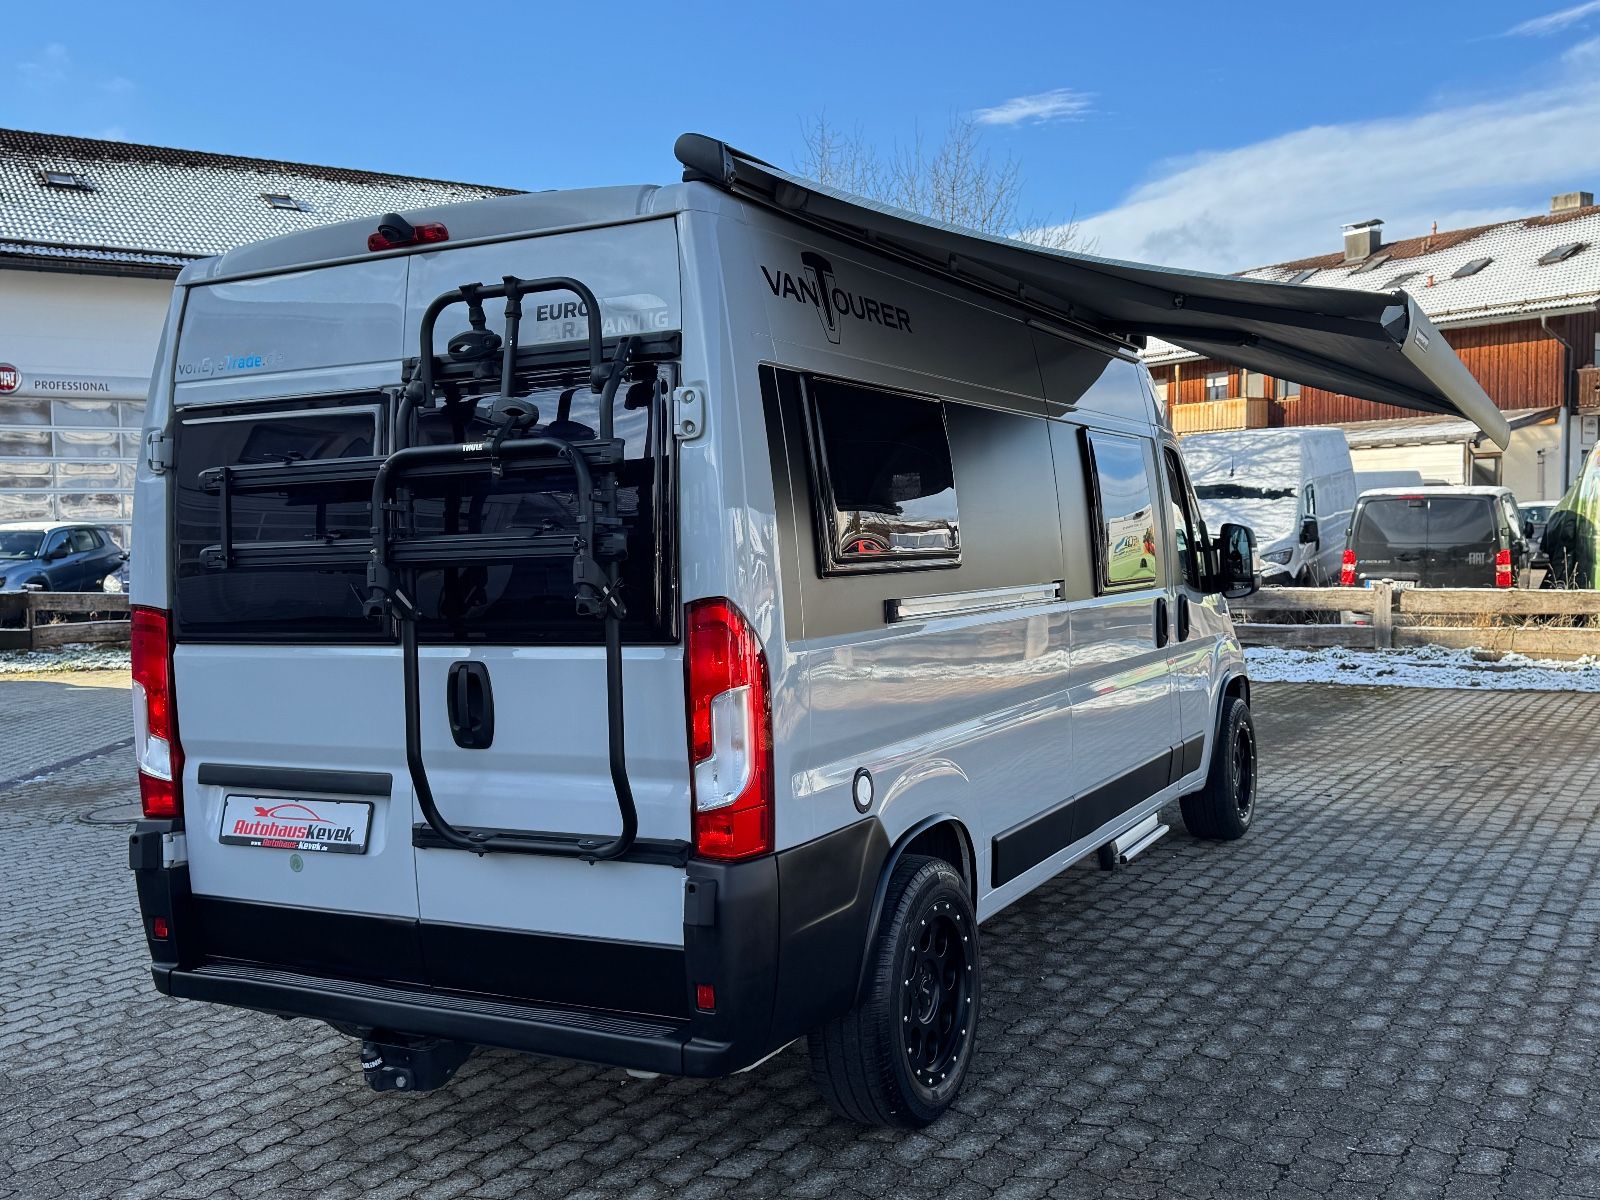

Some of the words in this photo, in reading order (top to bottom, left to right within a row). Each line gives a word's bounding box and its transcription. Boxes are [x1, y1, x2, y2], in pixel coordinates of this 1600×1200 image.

[760, 252, 913, 343] VANTOURER
[34, 380, 111, 392] PROFESSIONAL
[462, 443, 483, 452] THULE
[1468, 552, 1486, 565] FIAT
[233, 819, 355, 842] AutohausKevek
